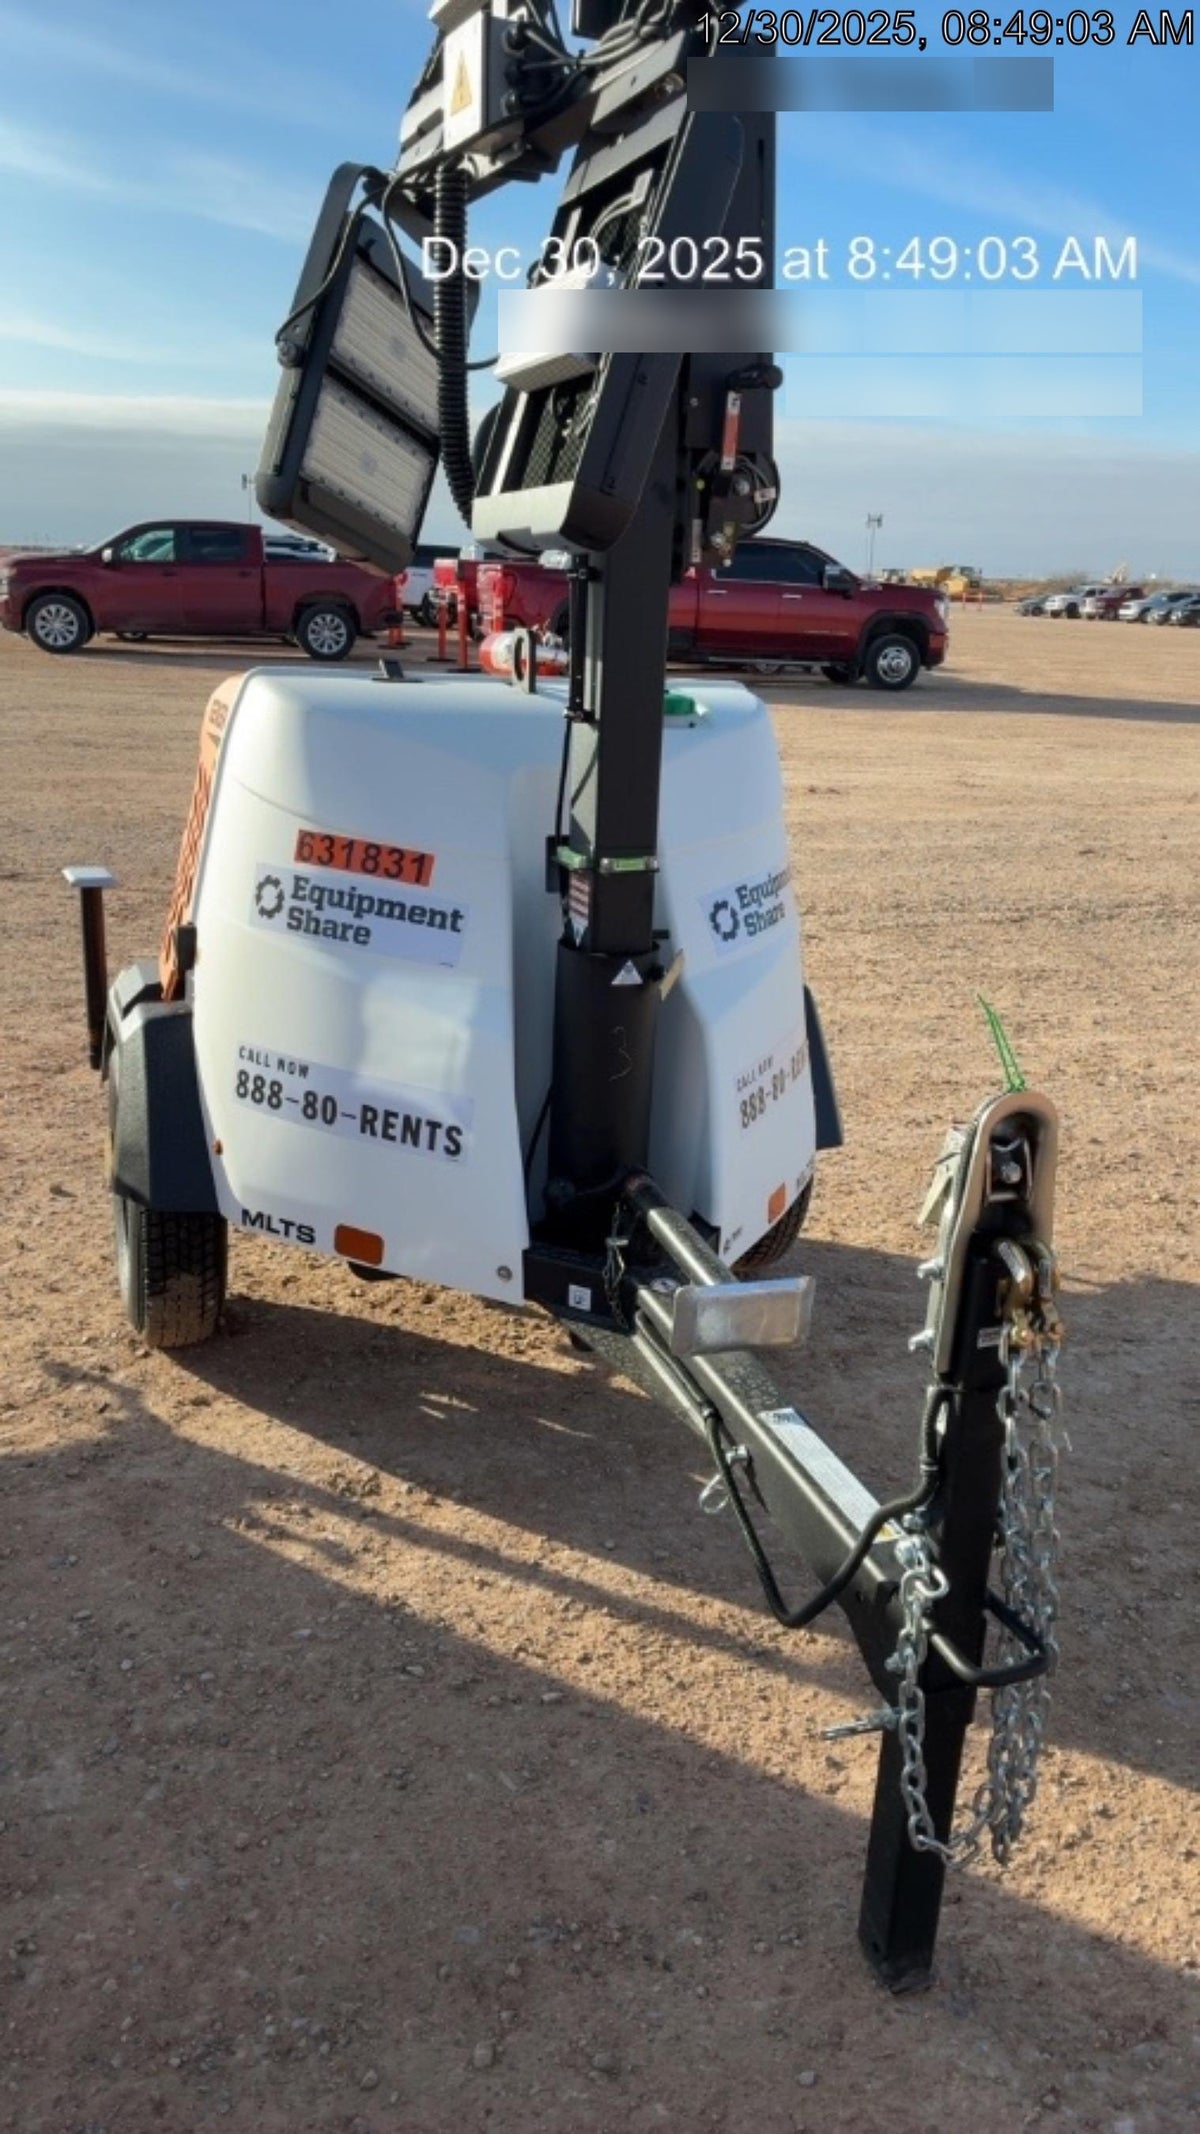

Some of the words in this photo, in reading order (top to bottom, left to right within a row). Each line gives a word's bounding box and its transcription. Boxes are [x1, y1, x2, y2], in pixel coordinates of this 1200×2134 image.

[296, 831, 432, 886] 631831
[285, 906, 372, 947] Share
[290, 874, 465, 935] Equipment
[237, 1044, 272, 1069] CALL
[276, 1058, 310, 1080] NOW
[235, 1068, 465, 1158] 888-80-RENTS
[240, 1207, 317, 1245] MLTS
